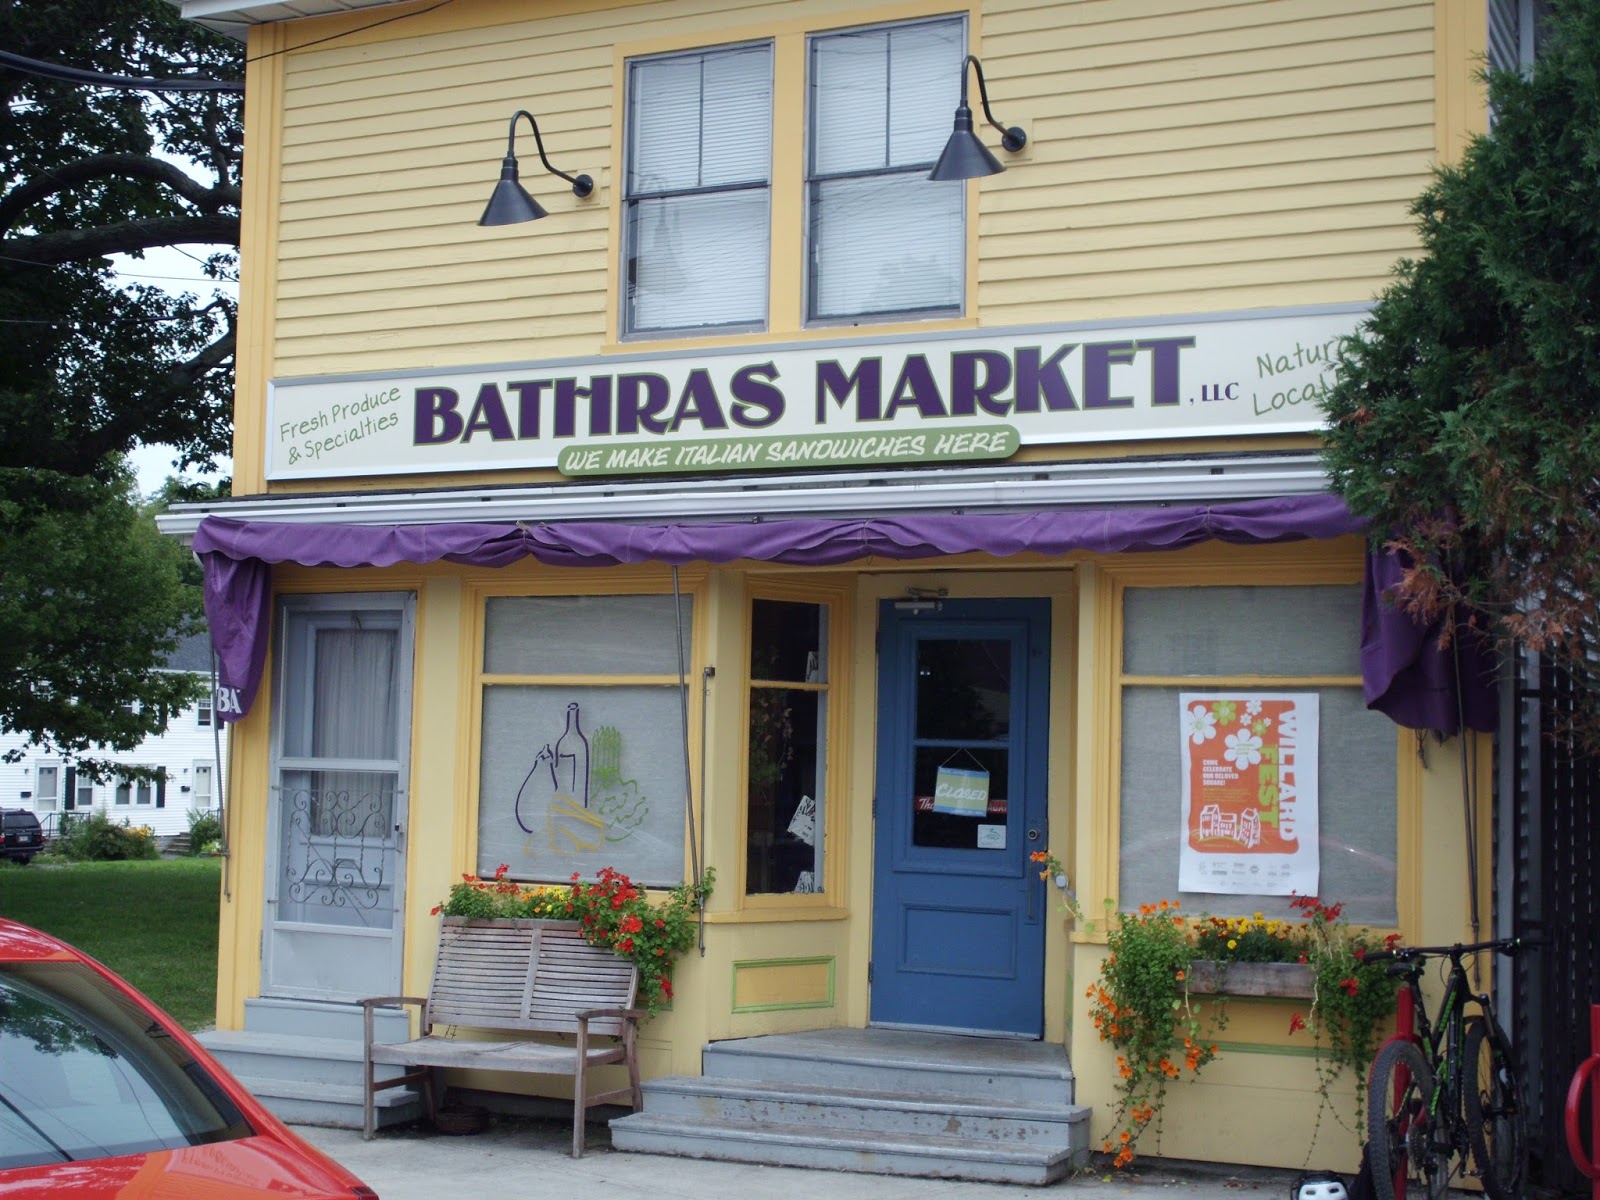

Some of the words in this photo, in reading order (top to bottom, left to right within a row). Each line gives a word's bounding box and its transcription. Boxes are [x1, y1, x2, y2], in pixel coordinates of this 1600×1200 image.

[279, 410, 328, 442] Fresh
[332, 386, 401, 424] Produce
[413, 360, 786, 446] BATHRAS
[288, 447, 302, 465] &
[306, 410, 399, 459] Specialties
[565, 449, 602, 470] WE
[606, 447, 669, 469] MAKE
[676, 443, 763, 466] ITALIAN
[766, 434, 927, 462] SANDWICHES
[935, 432, 1009, 454] HERE
[217, 687, 242, 714] BA
[1258, 744, 1279, 828] FEST
[1278, 711, 1298, 841] WILLARD
